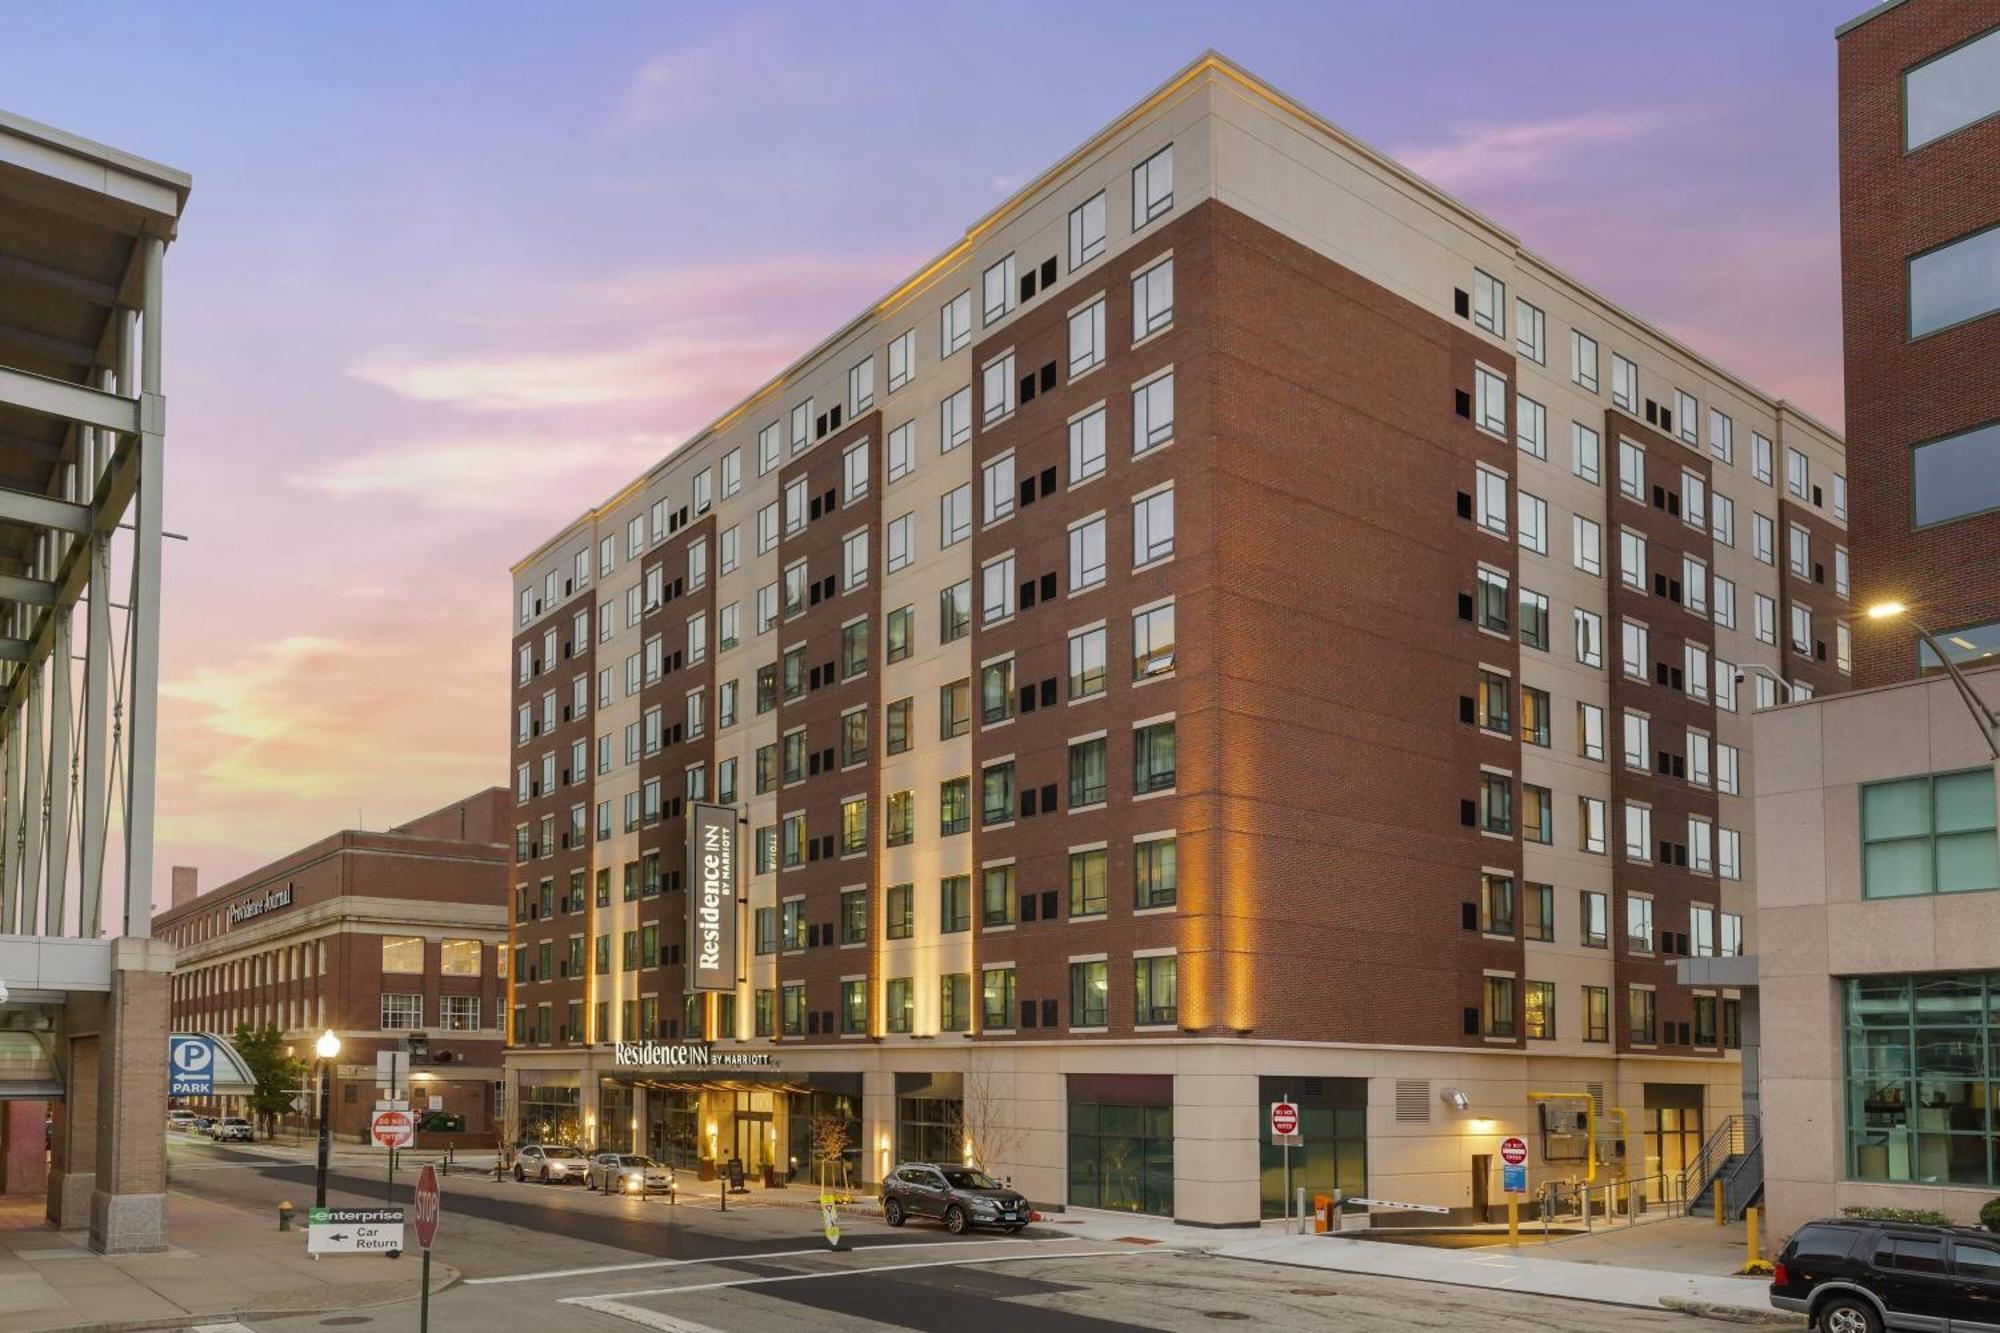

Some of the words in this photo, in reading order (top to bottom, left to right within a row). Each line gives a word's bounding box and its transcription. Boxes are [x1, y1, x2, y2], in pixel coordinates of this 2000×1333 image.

[705, 825, 720, 851] INN
[722, 828, 731, 881] MARRIOTT
[722, 885, 731, 896] BY
[230, 896, 264, 924] Providence
[263, 882, 291, 912] Journal
[699, 854, 720, 970] Residence
[184, 1044, 205, 1067] P
[615, 1041, 687, 1065] Residence
[690, 1046, 708, 1064] INN
[712, 1055, 722, 1065] BY
[724, 1054, 769, 1065] MARRIOTT
[173, 1083, 210, 1093] PARK
[311, 1210, 403, 1223] enterprise
[416, 1191, 437, 1222] STOP
[356, 1227, 379, 1237] Car
[356, 1239, 398, 1249] Return
